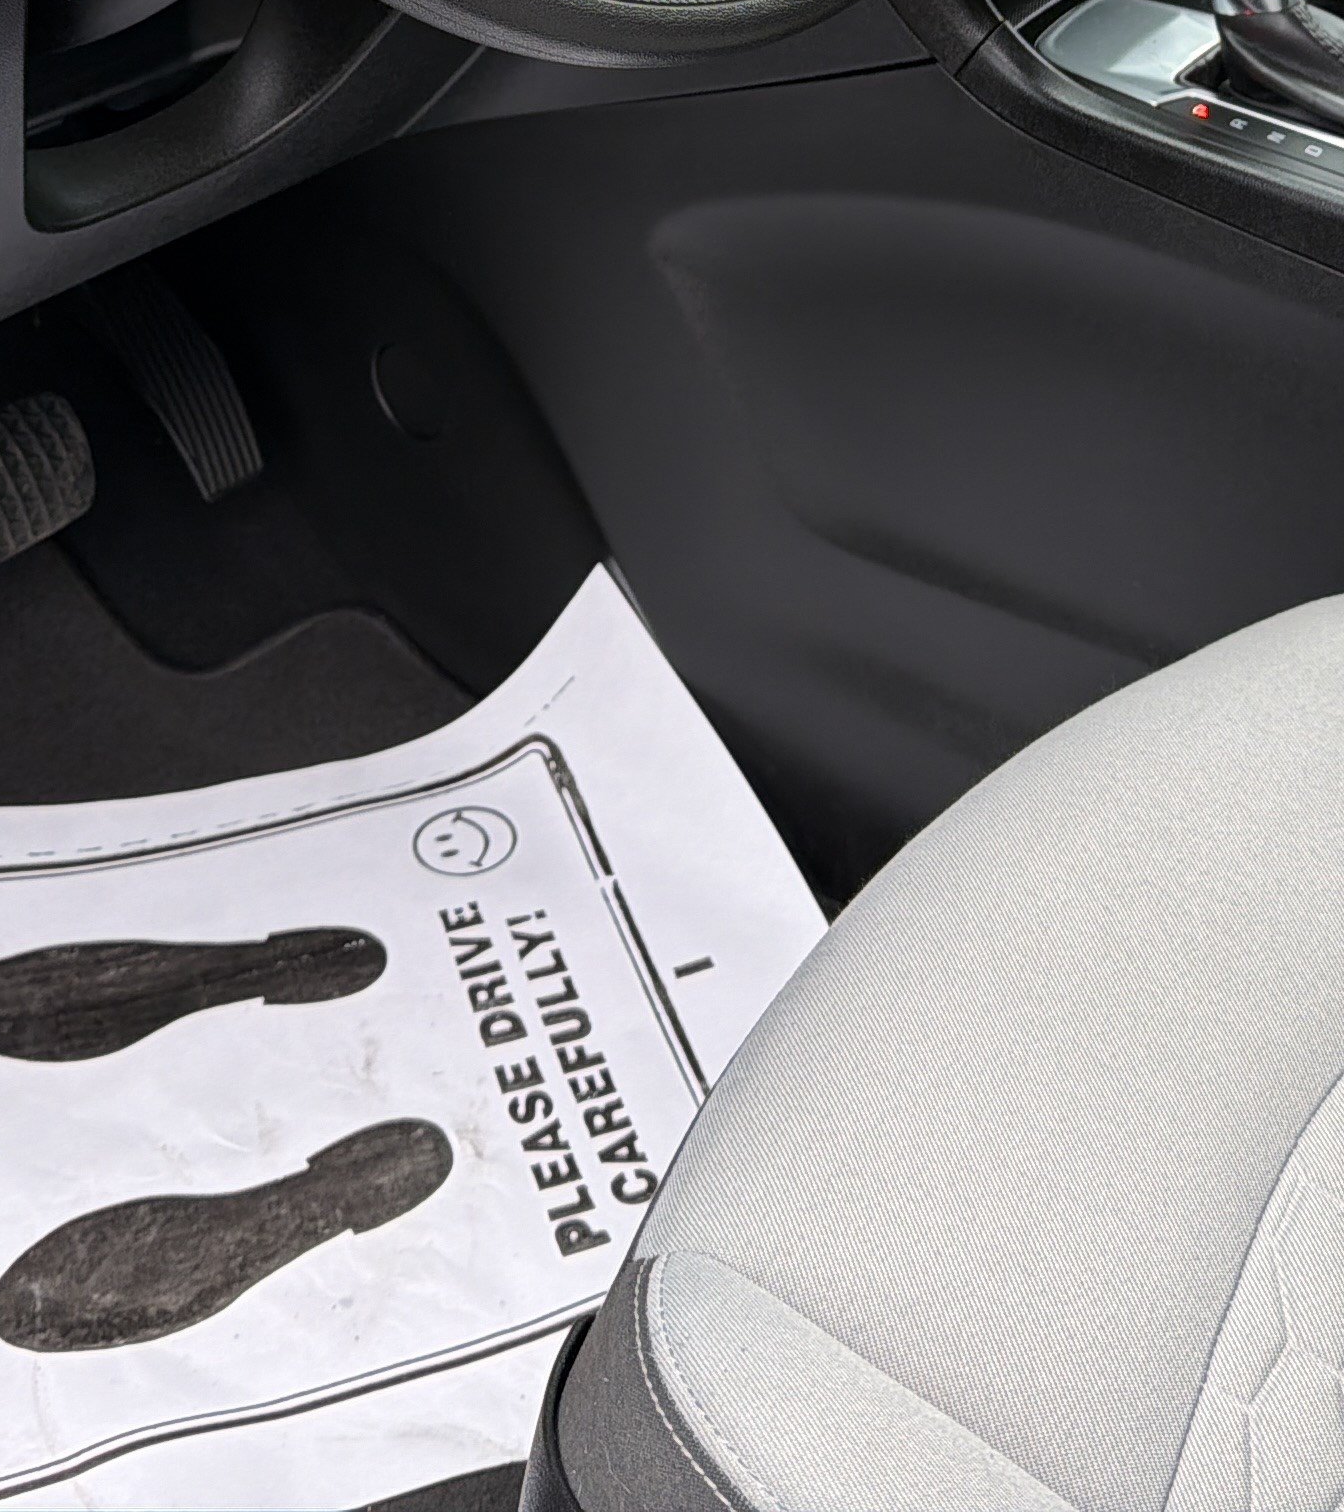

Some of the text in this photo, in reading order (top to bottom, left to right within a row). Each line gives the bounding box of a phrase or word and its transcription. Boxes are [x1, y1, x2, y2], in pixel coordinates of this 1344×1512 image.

[437, 900, 612, 1258] PLEASE DRIVE
[505, 908, 658, 1206] CAREFULLY!
